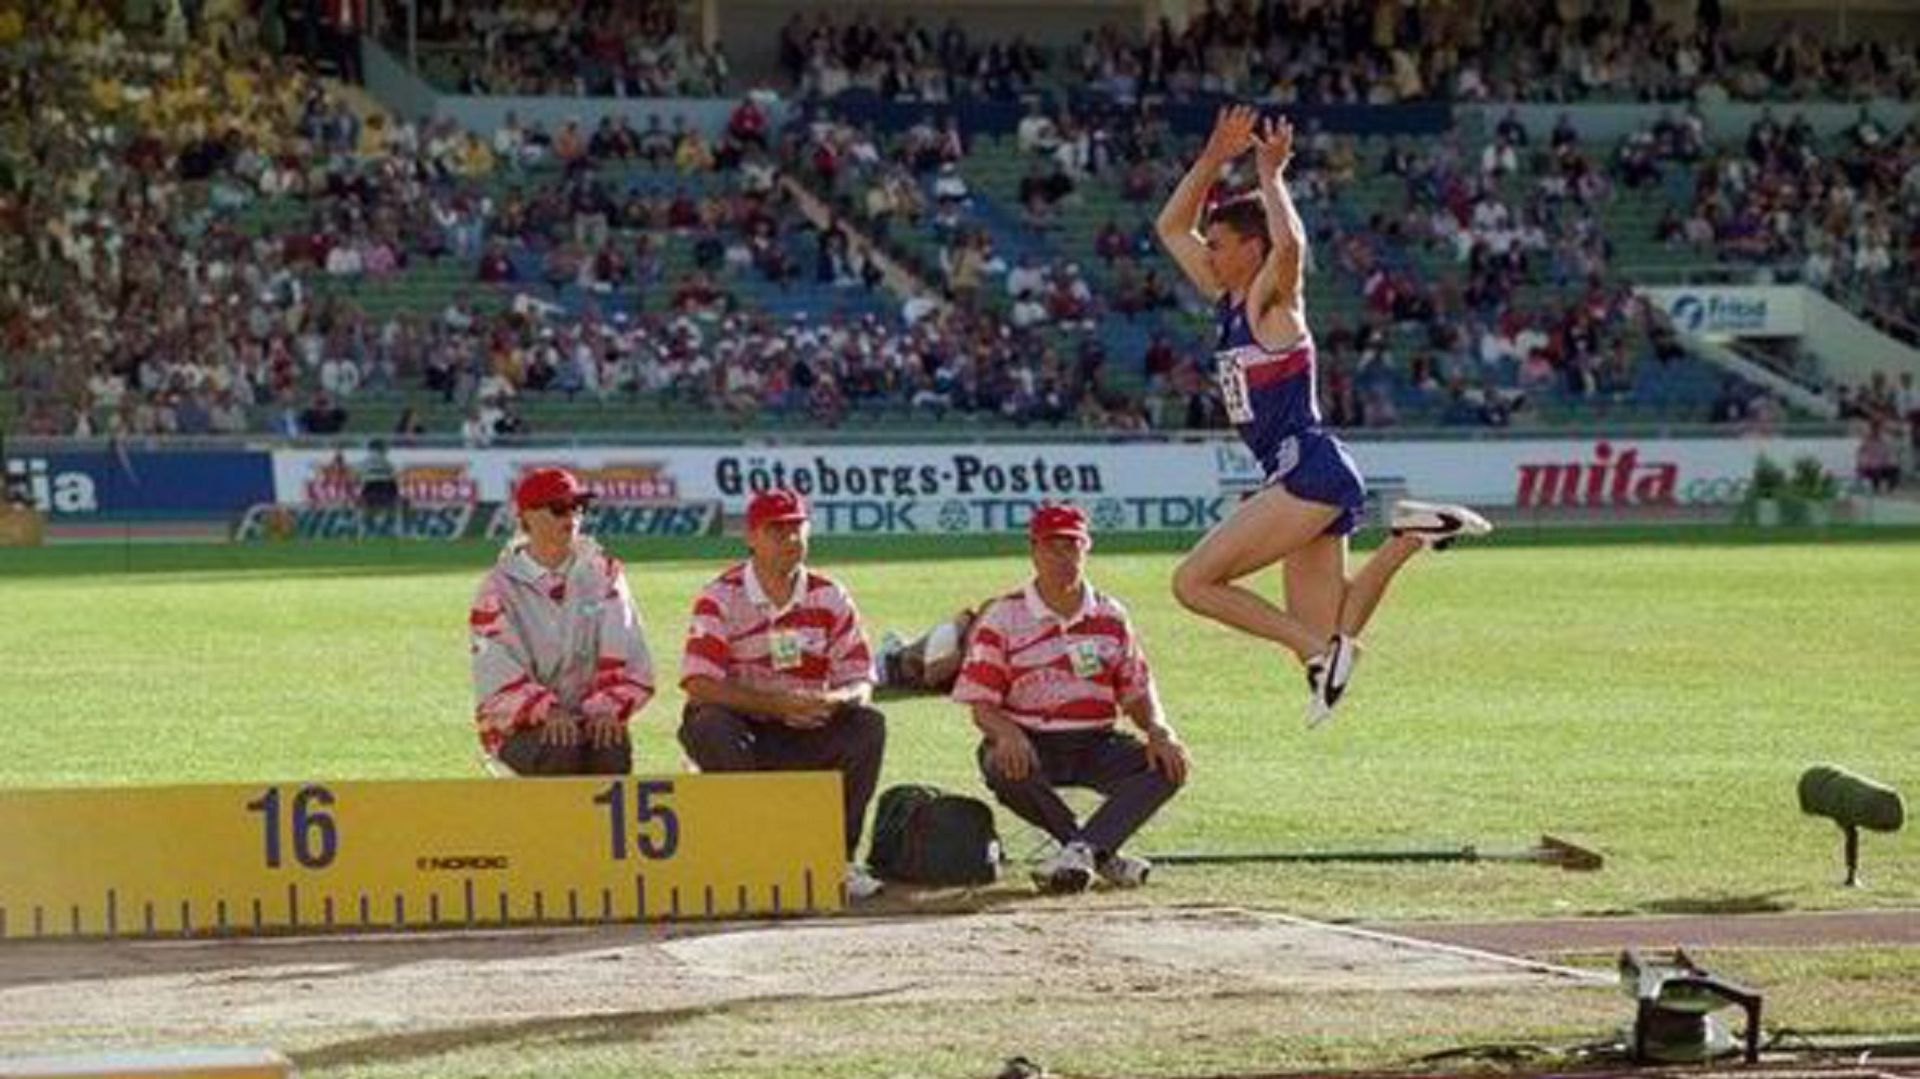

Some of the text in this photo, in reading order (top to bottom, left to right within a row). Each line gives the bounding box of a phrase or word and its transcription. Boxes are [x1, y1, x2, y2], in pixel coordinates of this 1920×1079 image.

[715, 455, 1102, 499] Göteborgs-Posten
[1517, 440, 1678, 508] mita
[812, 502, 917, 531] TDK
[971, 501, 1034, 530] TD
[1123, 500, 1226, 529] TDK
[247, 784, 338, 870] 16
[594, 779, 681, 861] 15
[430, 855, 508, 870] NORDIC
